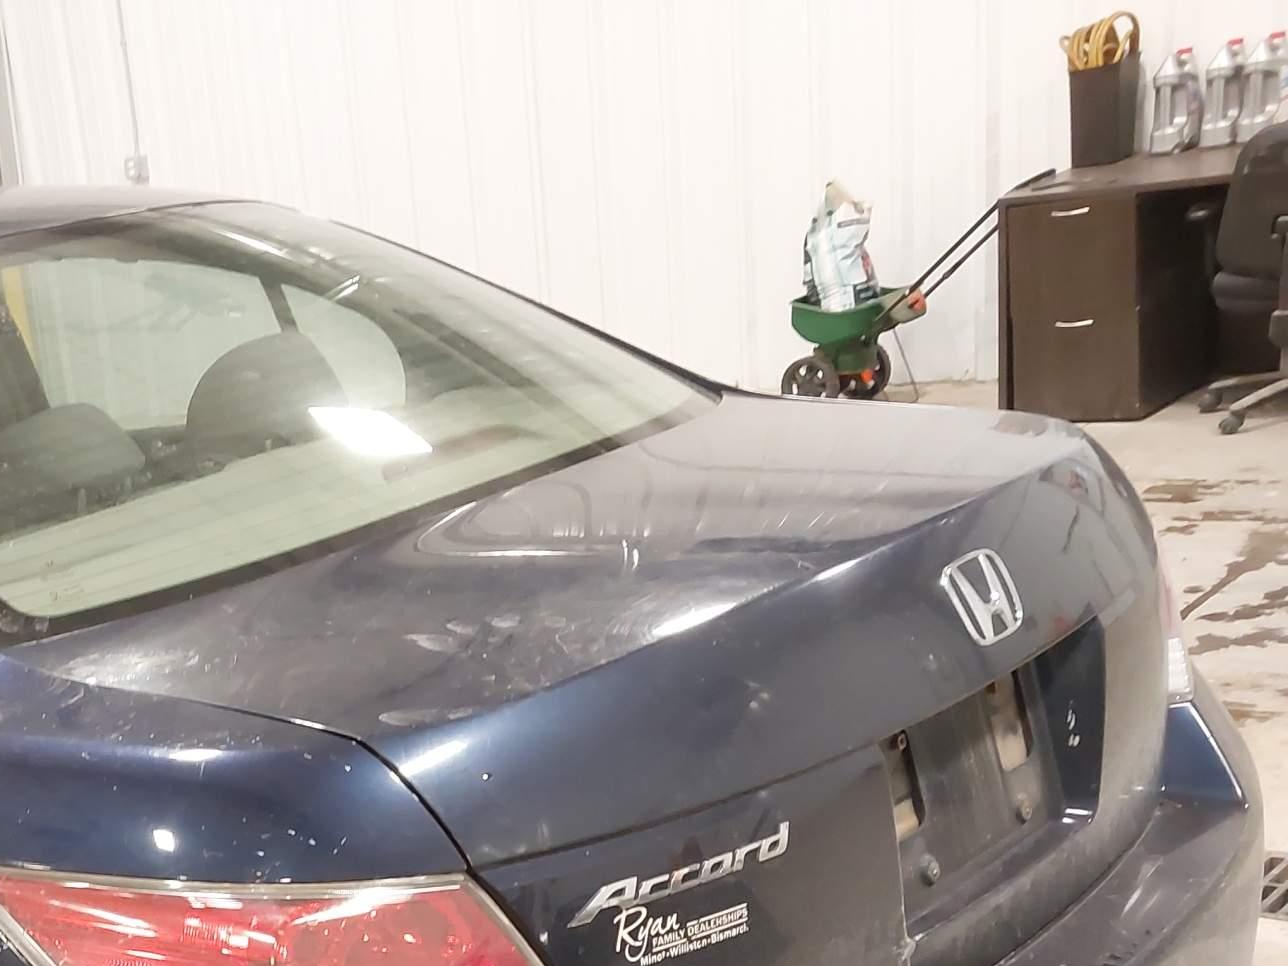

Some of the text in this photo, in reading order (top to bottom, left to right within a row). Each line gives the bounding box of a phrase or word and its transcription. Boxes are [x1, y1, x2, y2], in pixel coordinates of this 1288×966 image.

[567, 820, 790, 928] Accord
[613, 906, 680, 962] Ryan
[652, 907, 748, 947] FAMILY DEALERSHIPS
